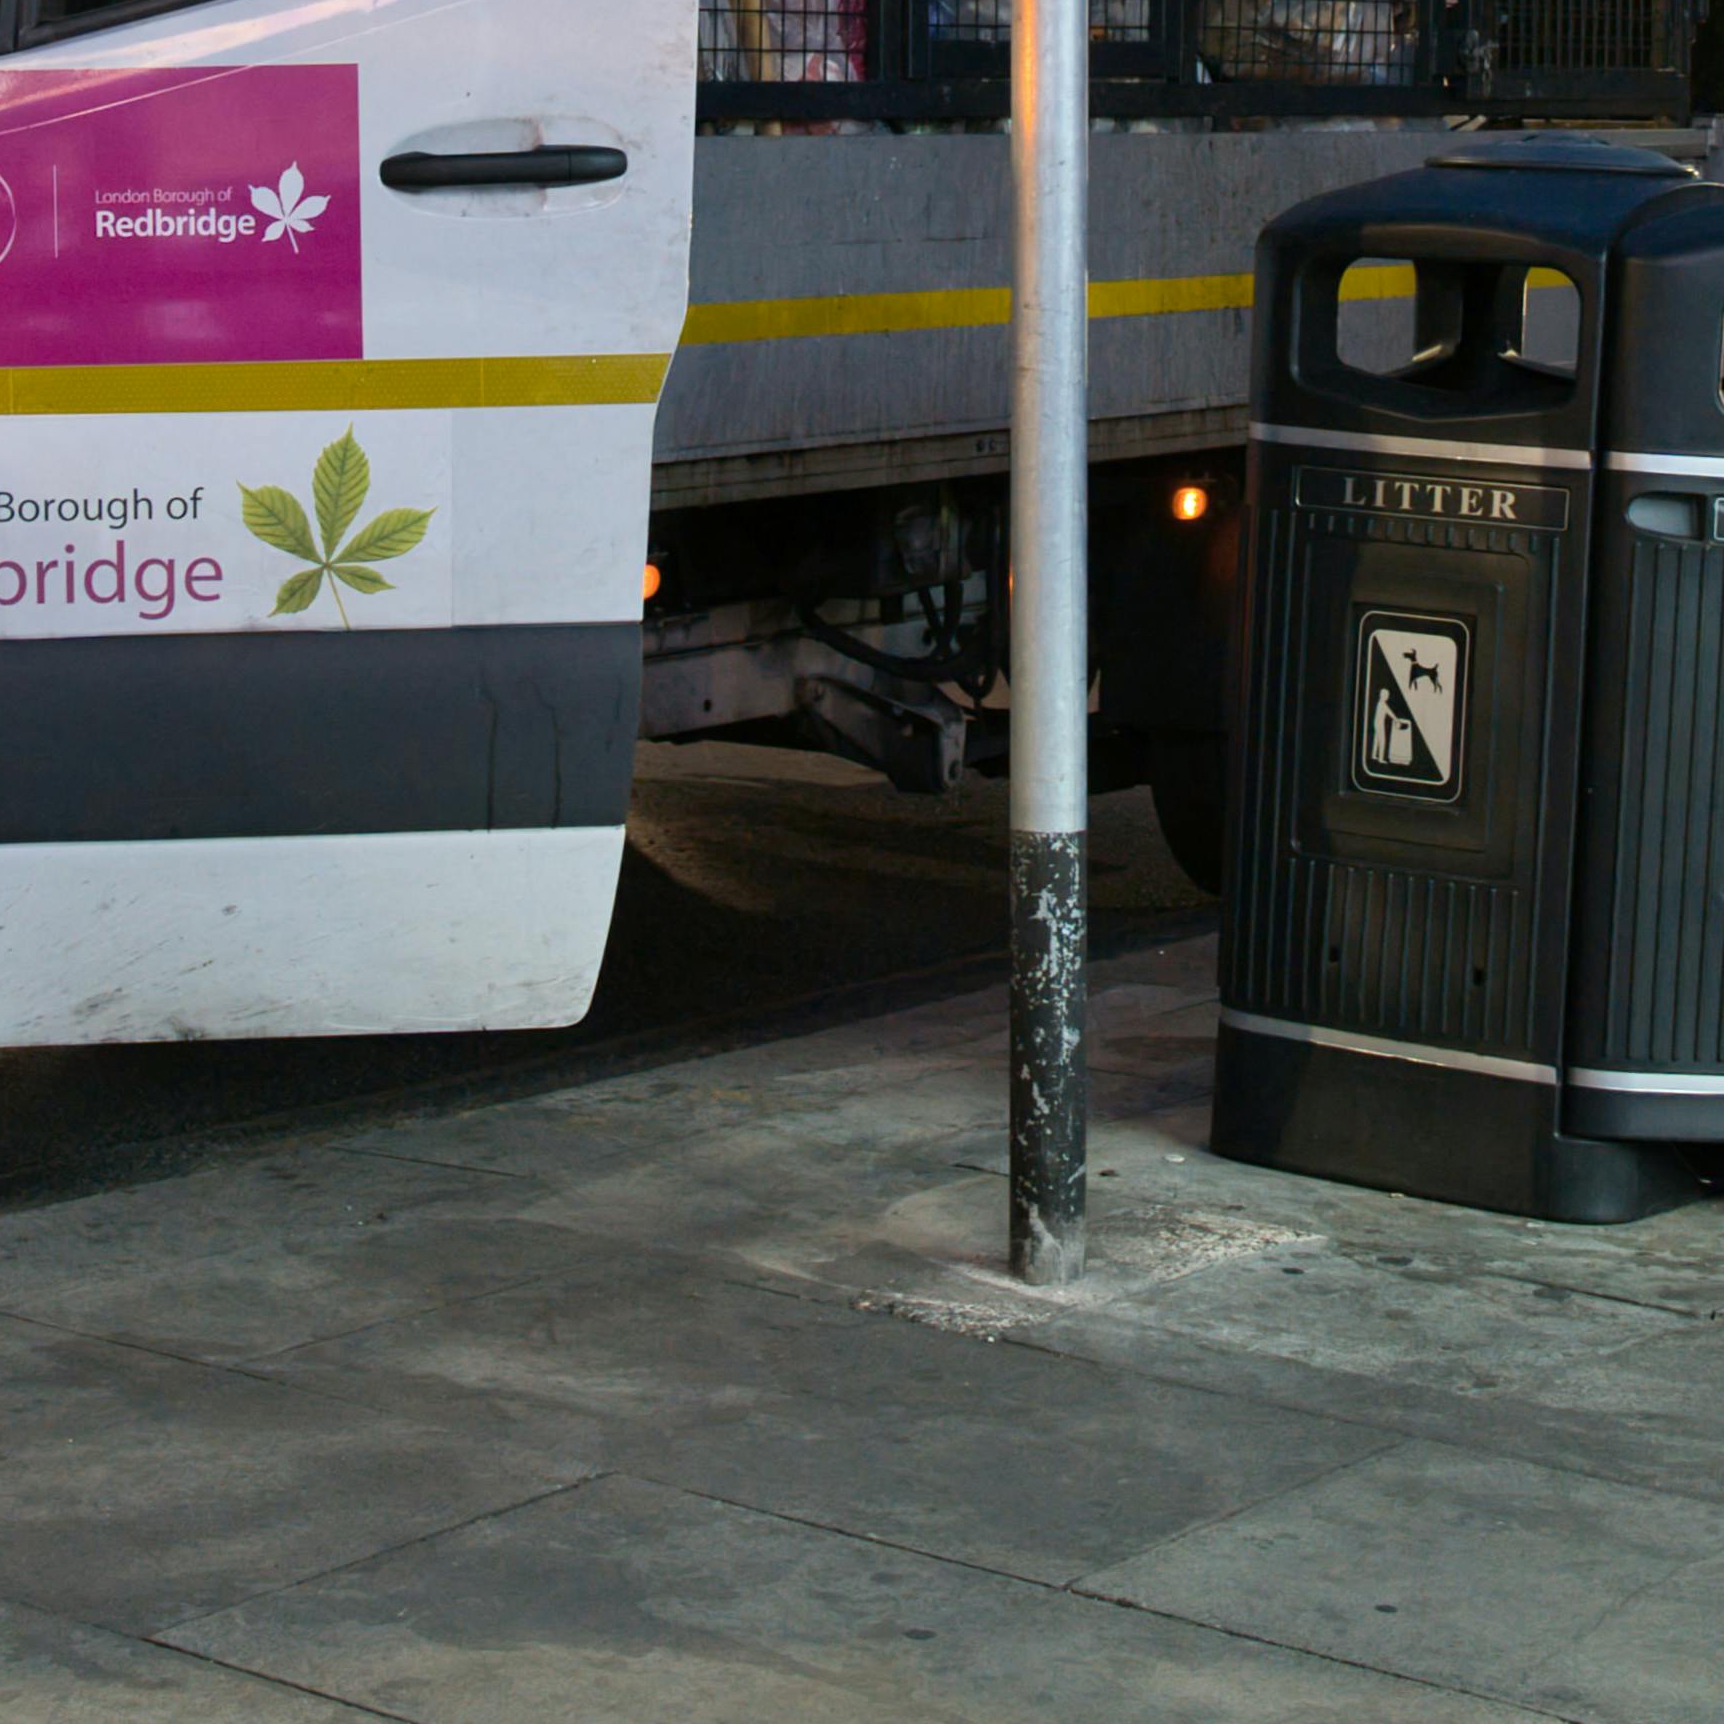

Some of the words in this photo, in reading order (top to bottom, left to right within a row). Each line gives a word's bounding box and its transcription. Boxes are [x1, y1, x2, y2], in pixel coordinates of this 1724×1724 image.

[95, 188, 150, 205] London
[153, 187, 215, 206] Borough
[217, 186, 234, 202] of
[95, 207, 257, 243] Redbridge
[165, 486, 205, 520] of
[1341, 476, 1518, 520] LITTER
